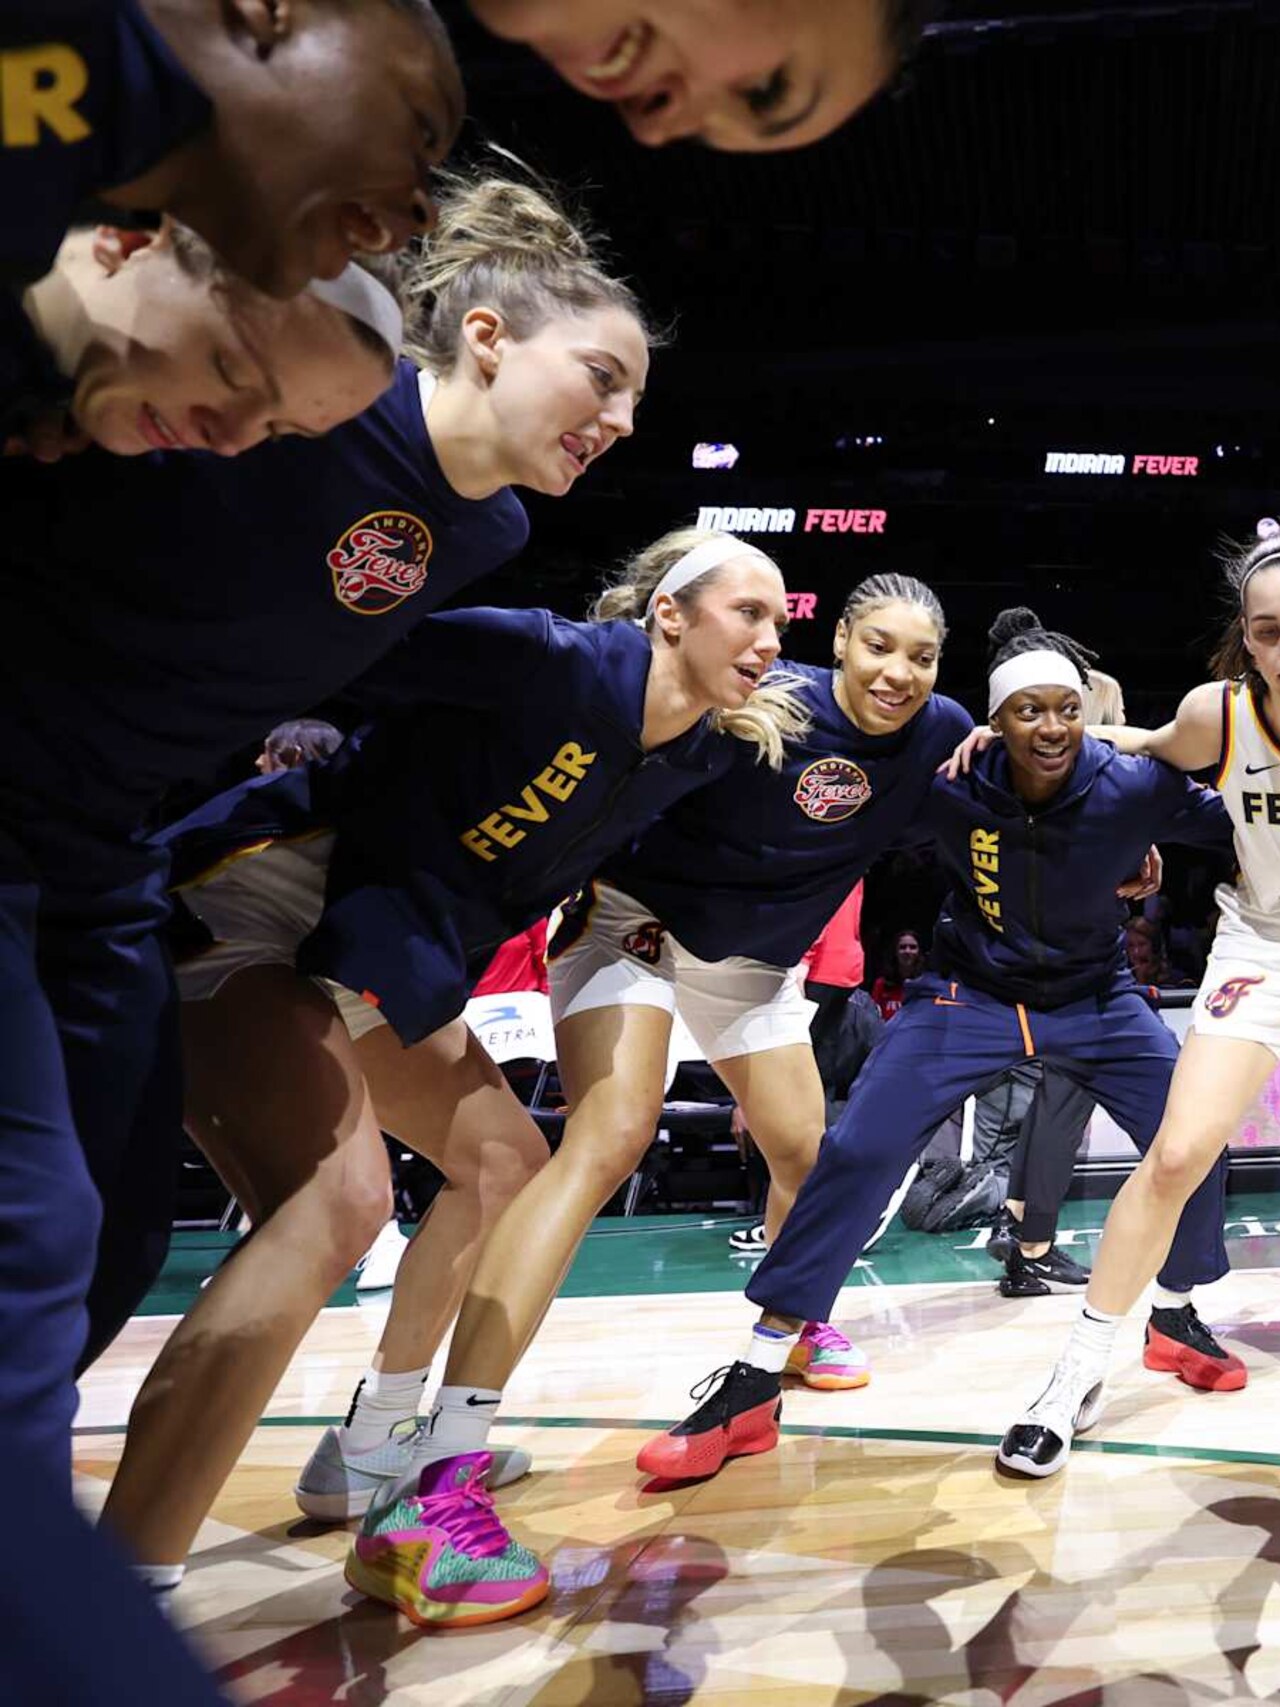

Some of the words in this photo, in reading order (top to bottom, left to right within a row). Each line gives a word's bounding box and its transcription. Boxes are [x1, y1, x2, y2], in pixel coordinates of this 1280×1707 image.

[1045, 452, 1125, 475] INDIANA
[1133, 454, 1198, 476] FEVER
[697, 506, 795, 533] INDIANA
[805, 508, 887, 533] FEVER
[326, 529, 428, 602] Fever
[459, 741, 597, 863] FEVER
[793, 774, 873, 818] Fever
